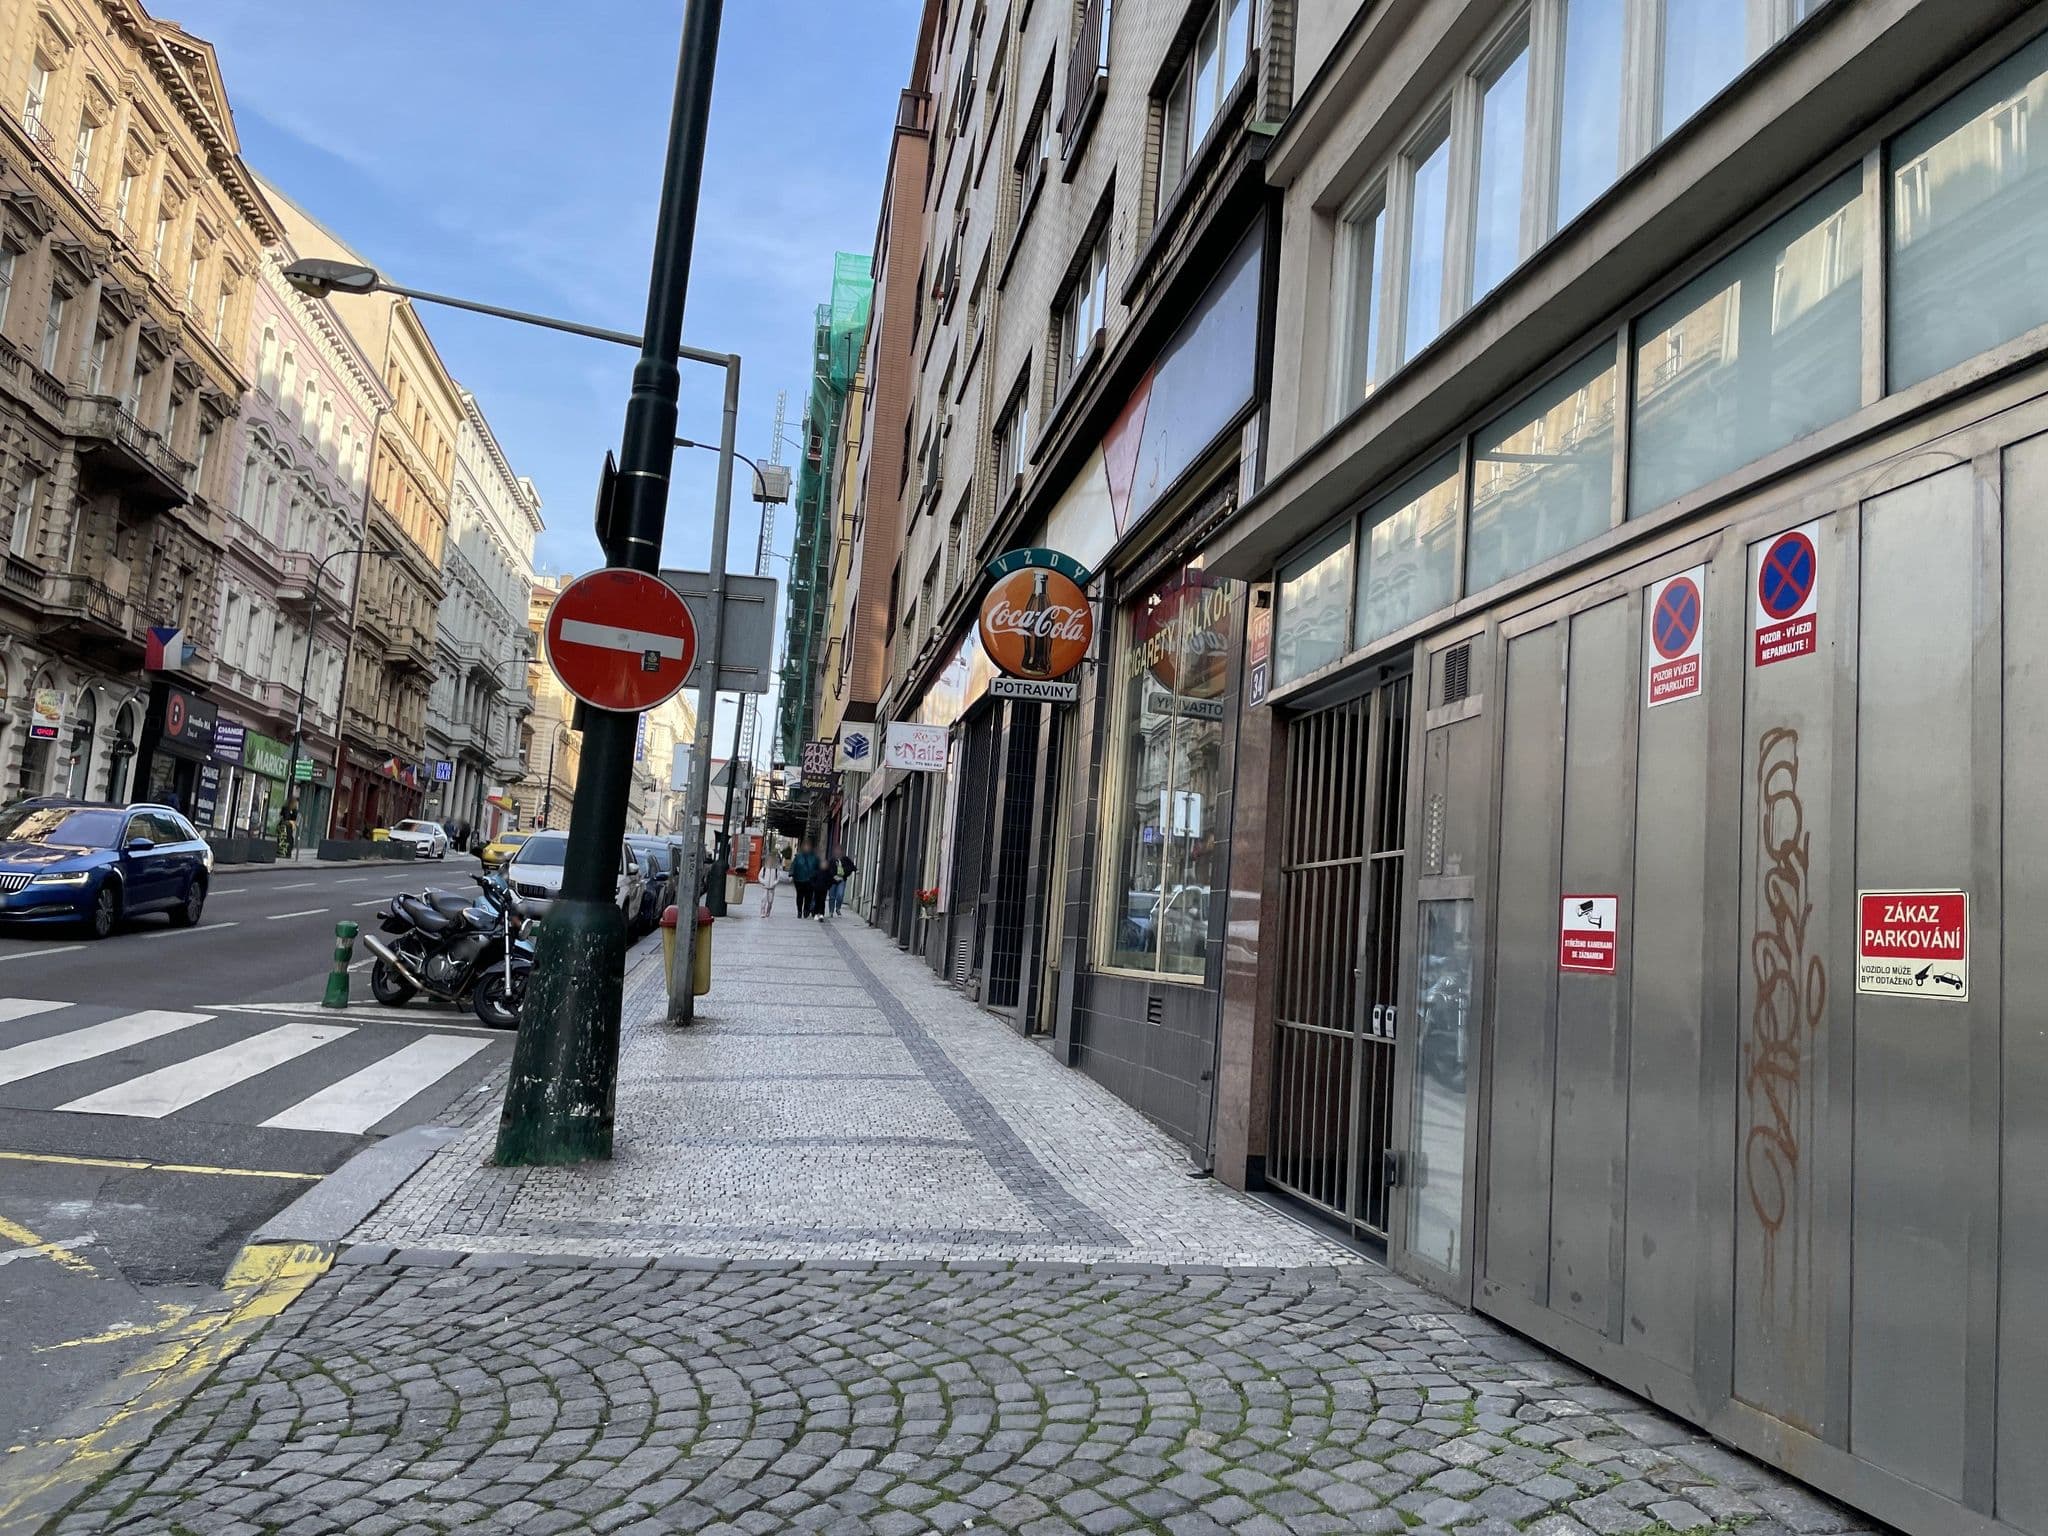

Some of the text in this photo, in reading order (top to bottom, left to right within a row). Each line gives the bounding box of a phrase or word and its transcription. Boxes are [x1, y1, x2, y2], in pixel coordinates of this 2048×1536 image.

[985, 600, 1089, 642] Coca-Cola
[1759, 630, 1782, 646] POZOR
[1786, 621, 1812, 640] VÝJEZD
[1761, 640, 1805, 661] NEPARKUJTE
[1652, 661, 1697, 683] POZOR VÝJEZD
[994, 681, 1074, 699] POTRAVINY
[1252, 669, 1264, 701] 34
[1653, 677, 1695, 697] NEPARKUJTE!
[217, 725, 244, 736] CHANGE
[804, 753, 833, 767] ZUM
[805, 743, 834, 757] ZUM
[896, 742, 944, 761] Nails
[254, 748, 289, 777] MARKET
[435, 770, 451, 780] BAR
[1883, 901, 1940, 923] ZÁKAZ
[1864, 926, 1961, 949] PARKOVÁNÍ
[1861, 965, 1891, 974] VOZIDLO
[1875, 976, 1914, 986] ODTAŽENO
